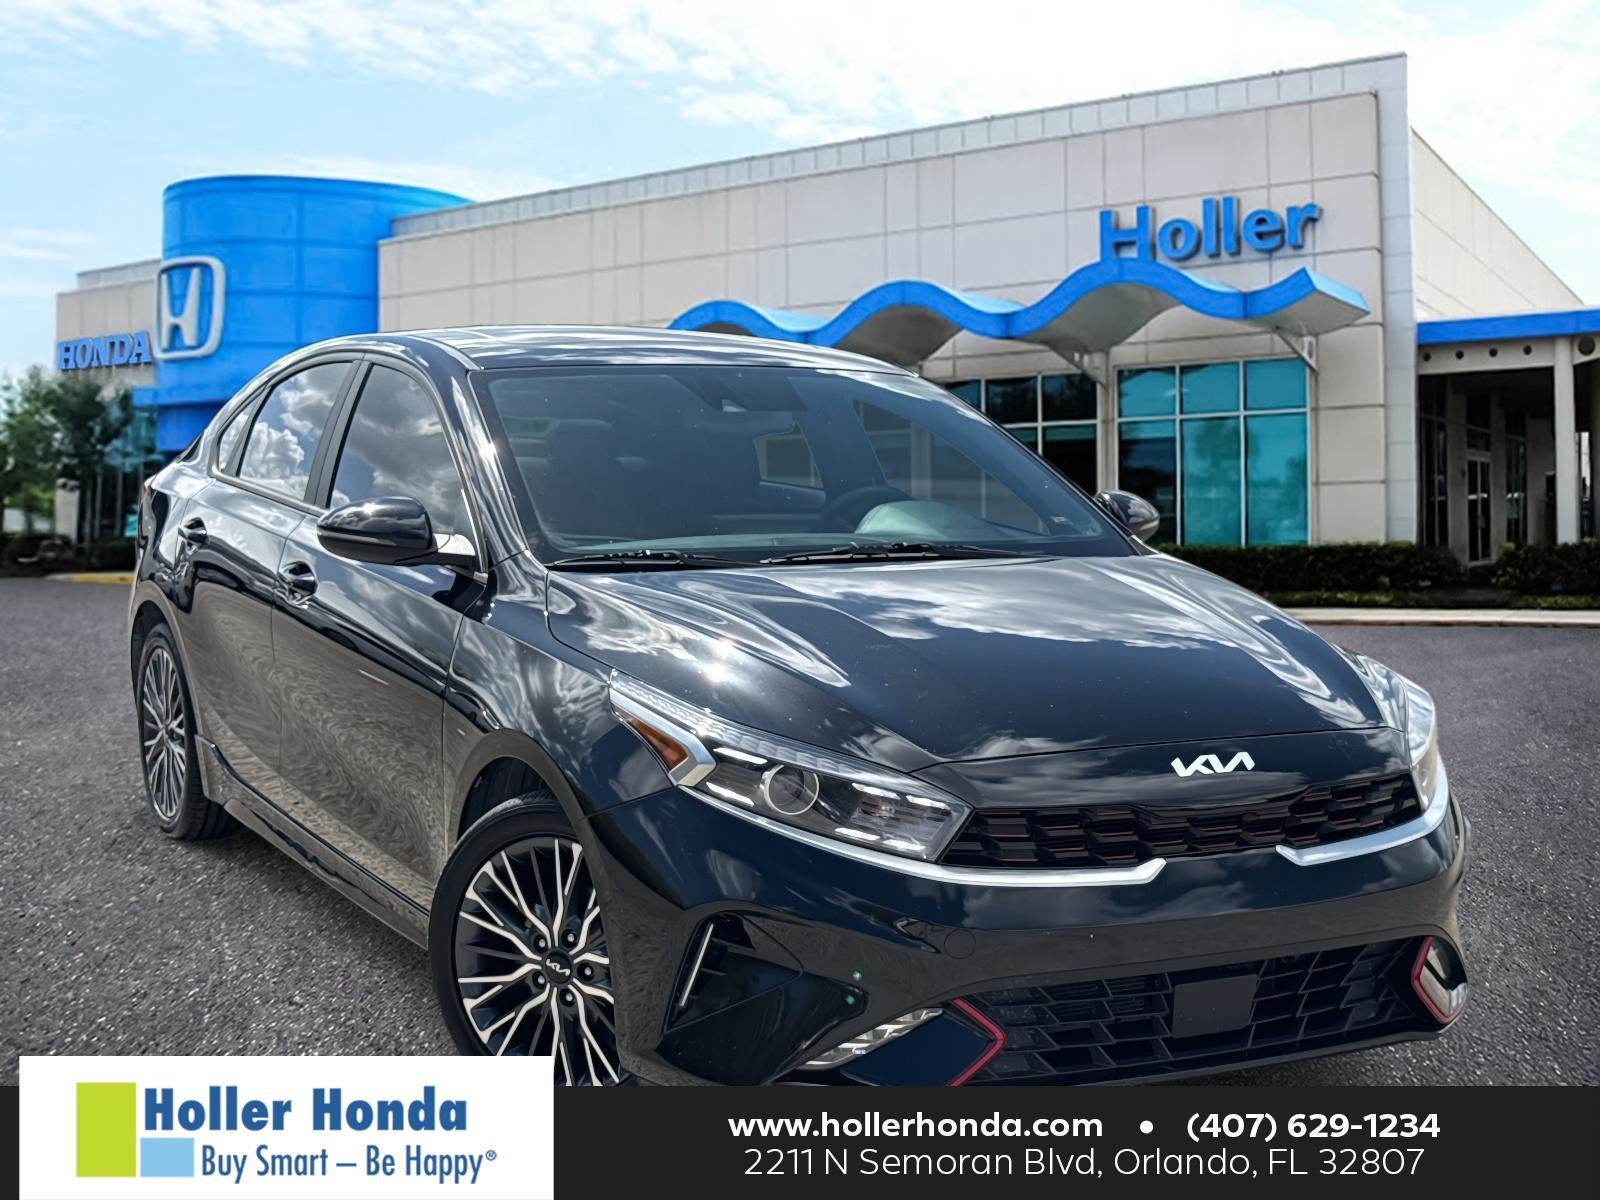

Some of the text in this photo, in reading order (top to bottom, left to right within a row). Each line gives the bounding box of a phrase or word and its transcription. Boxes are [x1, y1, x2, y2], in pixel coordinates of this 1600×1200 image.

[1100, 195, 1323, 262] Holler
[57, 331, 152, 371] HONDA
[1170, 751, 1256, 777] KIA
